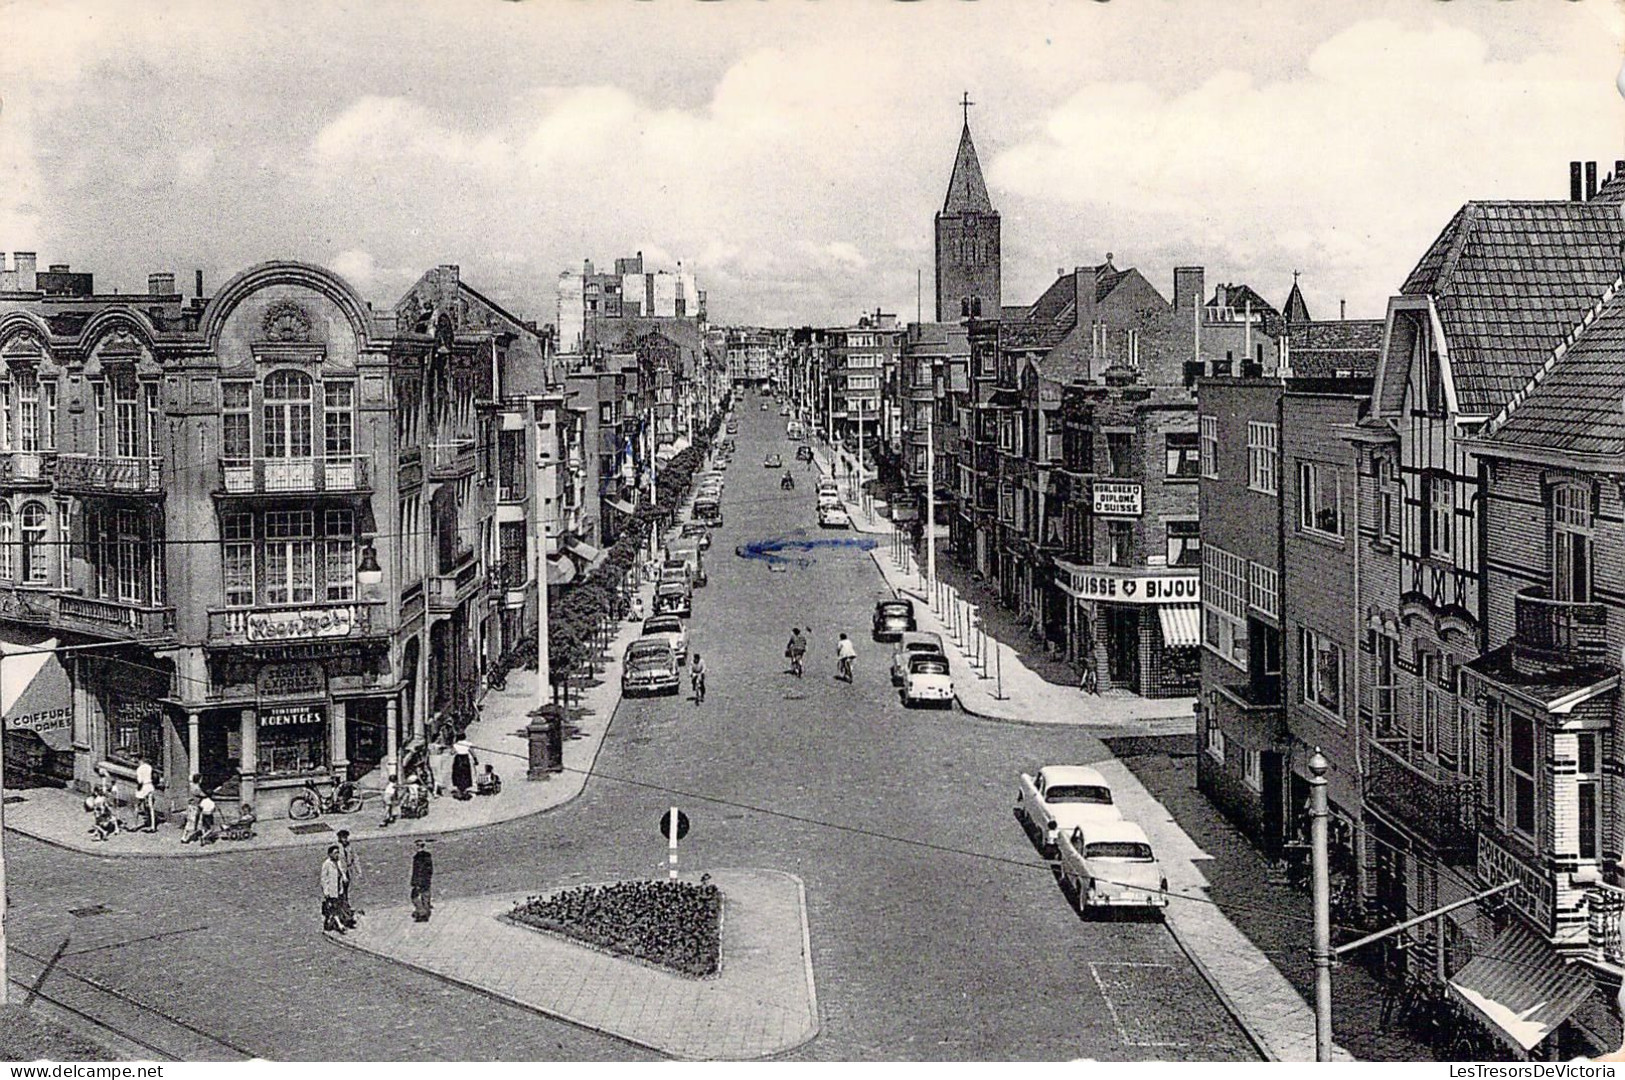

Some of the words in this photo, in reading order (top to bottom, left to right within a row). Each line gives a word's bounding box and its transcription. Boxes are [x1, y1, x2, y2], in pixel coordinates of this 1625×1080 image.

[1104, 503, 1139, 512] SUISSE
[1146, 579, 1200, 598] BIJOU
[264, 677, 318, 690] EXPRESS
[13, 707, 72, 726] COIFFURE
[261, 713, 321, 727] KOENTGES
[35, 718, 72, 732] DAMES
